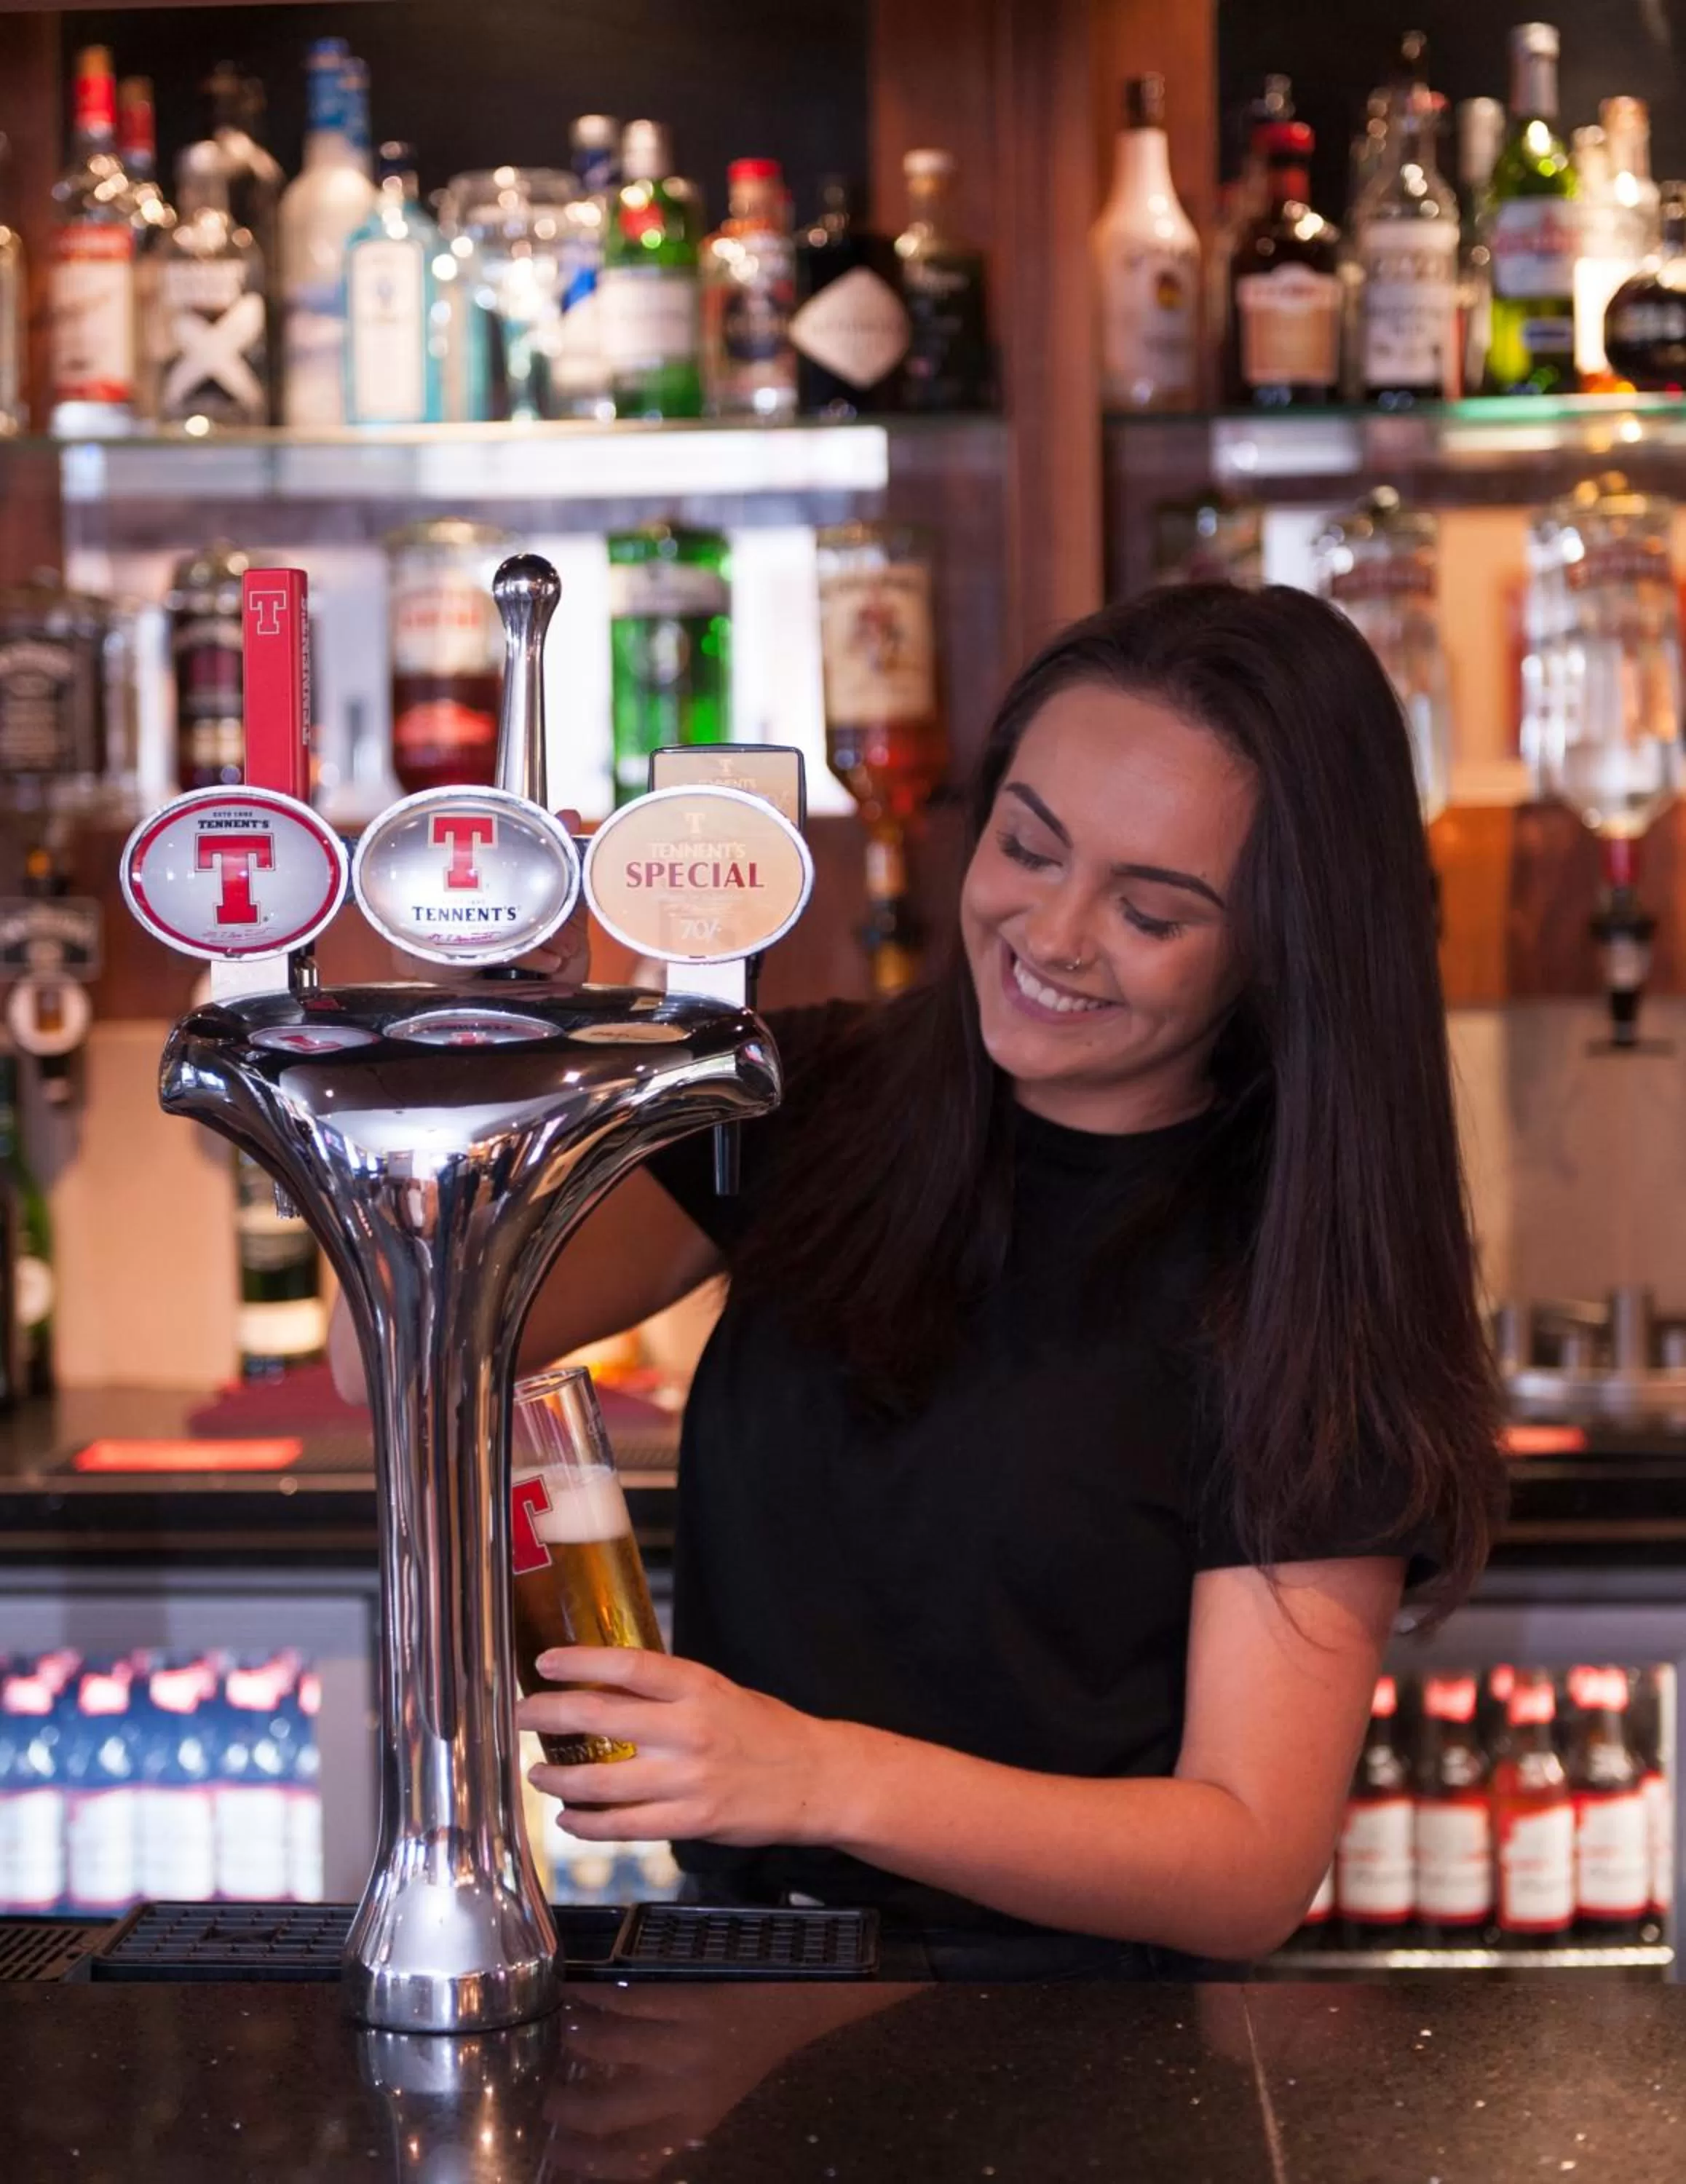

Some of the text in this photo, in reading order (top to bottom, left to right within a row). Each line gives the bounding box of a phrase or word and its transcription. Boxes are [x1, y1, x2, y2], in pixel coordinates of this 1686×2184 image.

[249, 590, 287, 636] T
[197, 820, 269, 829] TENNENT'S
[685, 812, 706, 835] T
[430, 813, 497, 891] T
[647, 841, 747, 859] TENNENT'S
[195, 833, 274, 925] T
[625, 861, 765, 888] SPECIAL
[411, 906, 518, 922] TENNENT'S
